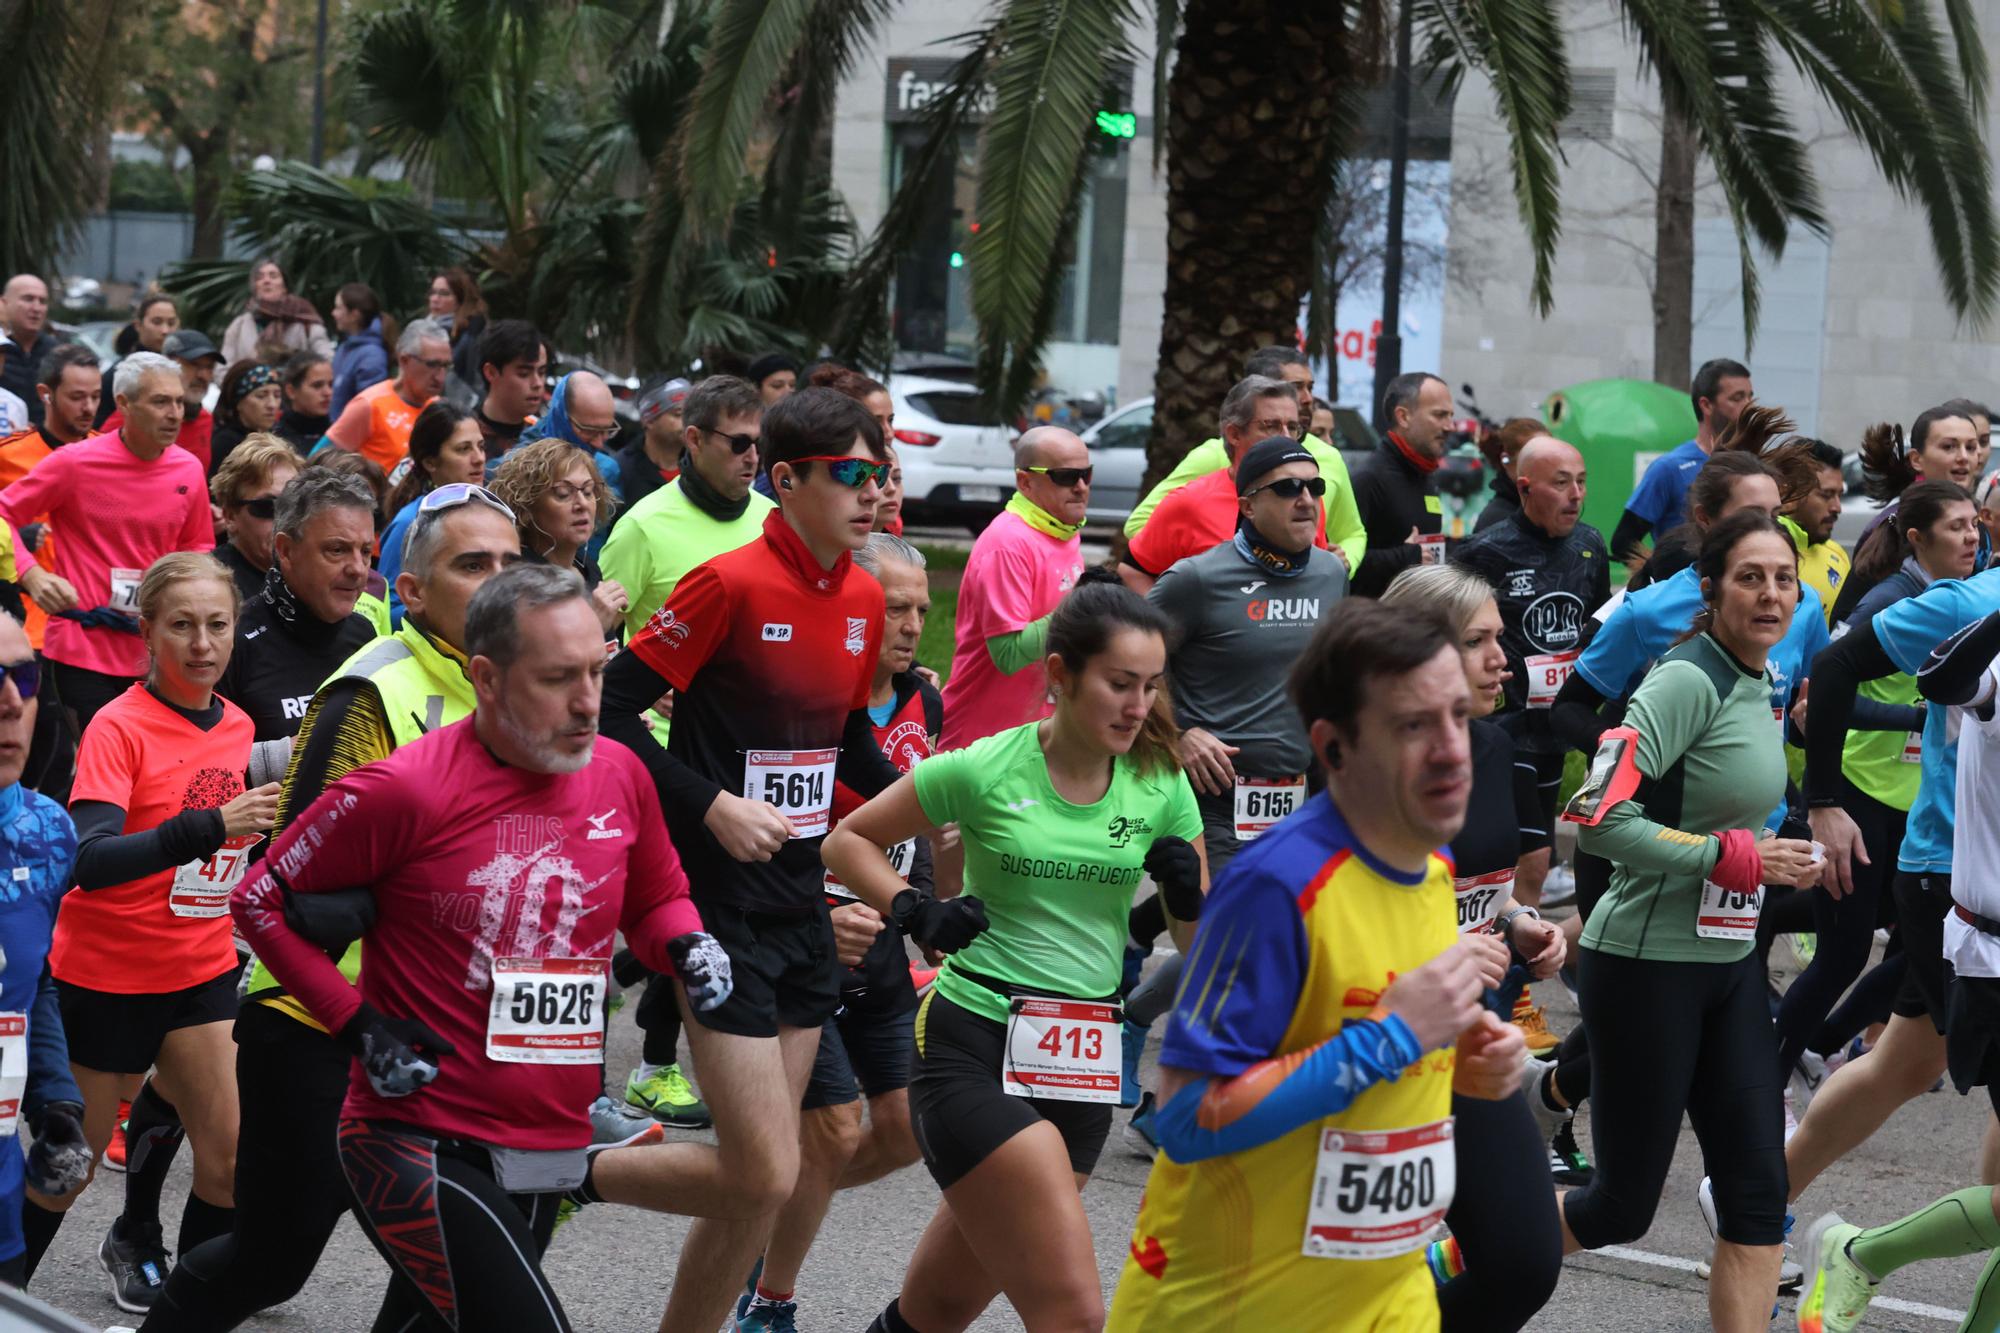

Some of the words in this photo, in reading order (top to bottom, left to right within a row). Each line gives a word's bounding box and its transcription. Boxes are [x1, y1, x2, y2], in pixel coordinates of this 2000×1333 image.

[764, 771, 824, 808] 5614
[1247, 791, 1293, 818] 6155
[493, 814, 564, 855] THIS
[511, 981, 594, 1026] 5626
[1037, 1025, 1103, 1060] 413
[1337, 1156, 1435, 1214] 5480
